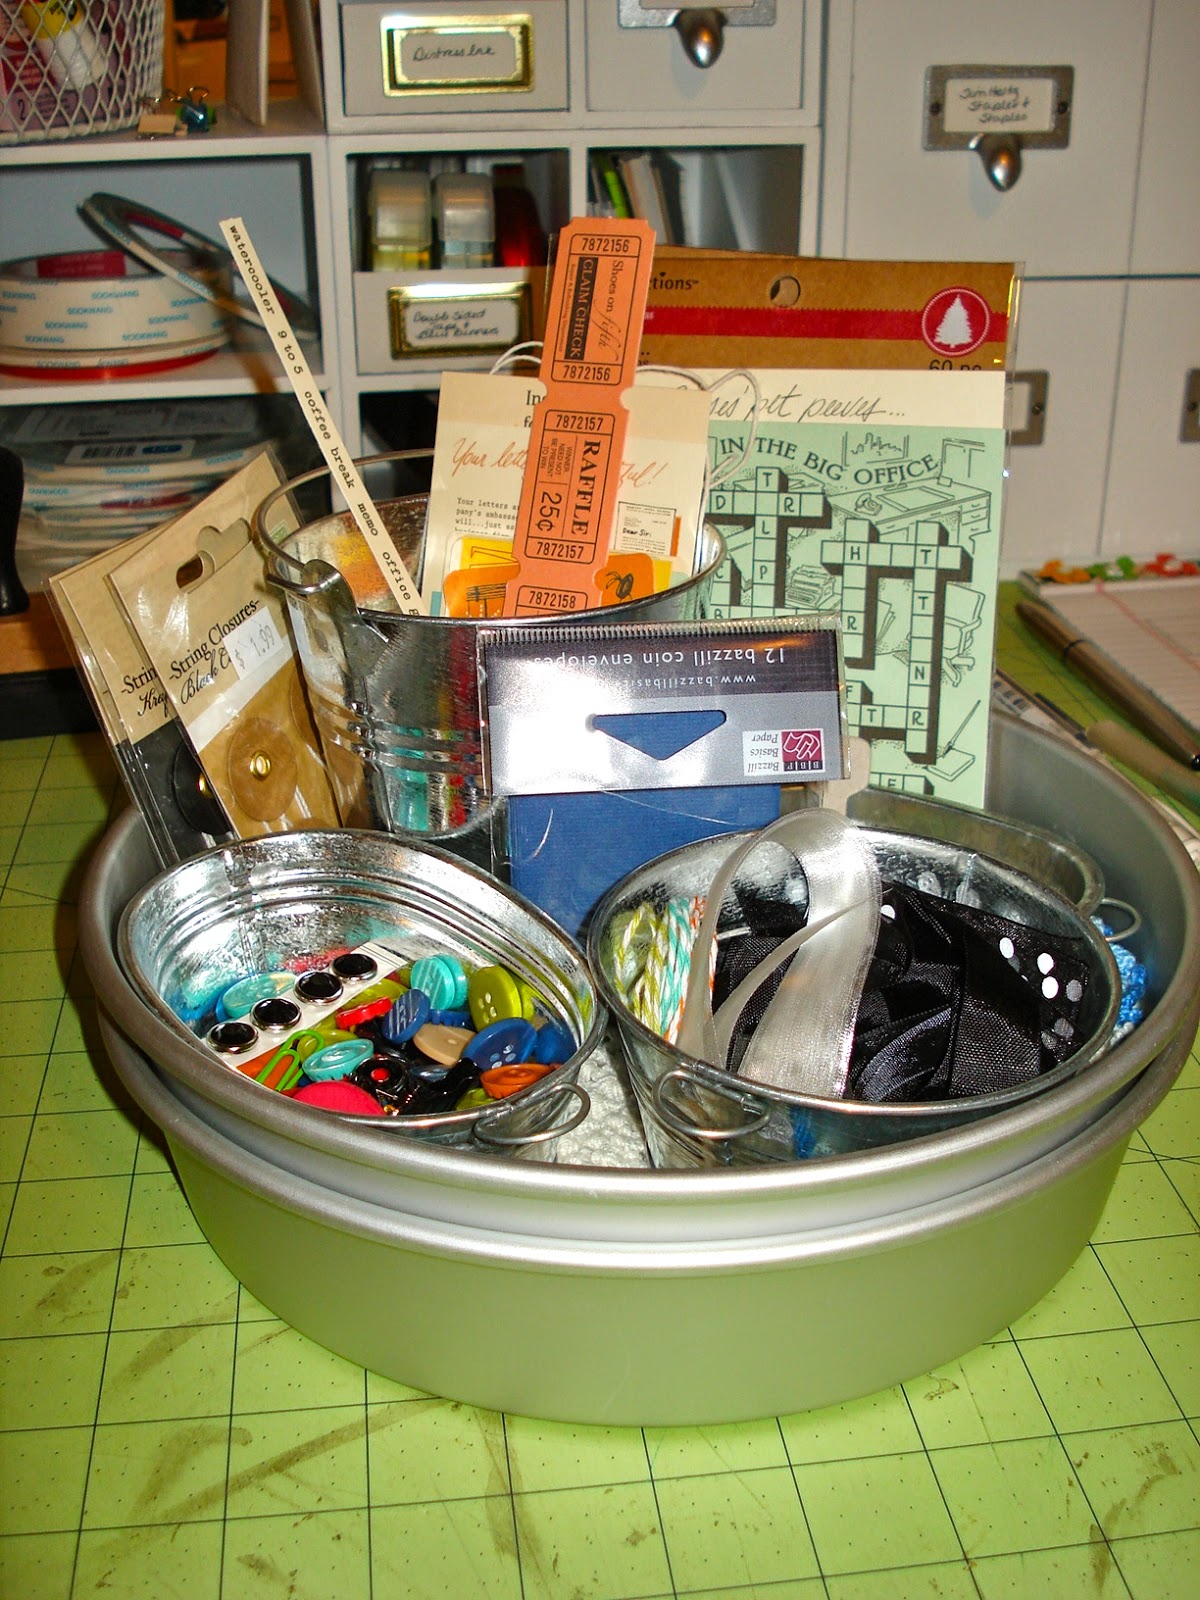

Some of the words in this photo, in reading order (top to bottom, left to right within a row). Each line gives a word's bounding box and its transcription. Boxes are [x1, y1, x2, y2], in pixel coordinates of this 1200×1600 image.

[581, 237, 630, 253] 7872156
[579, 259, 594, 303] CLAIM
[608, 259, 625, 295] Shoes
[605, 296, 617, 313] on
[569, 306, 588, 358] CHECK
[563, 365, 611, 381] 7872156
[229, 225, 275, 315] watercooler
[277, 330, 287, 339] 9
[284, 345, 295, 361] to
[293, 366, 304, 375] 5
[304, 391, 331, 440] coffee
[330, 447, 355, 489] break
[357, 502, 378, 537] memo
[382, 551, 411, 601] office
[556, 414, 604, 431] 7872157
[452, 438, 487, 477] Your
[720, 437, 744, 454] IN
[755, 437, 798, 460] THE
[803, 451, 844, 480] BIG
[854, 454, 939, 485] OFFICE
[571, 440, 602, 536] RAFFLE
[457, 497, 475, 507] Your
[478, 498, 509, 510] letters
[537, 491, 562, 532] 25¢
[623, 527, 638, 535] Dear
[536, 542, 584, 559] 7872157
[529, 591, 576, 608] 7872158
[534, 652, 633, 666] envelopes
[643, 651, 684, 667] coin
[694, 649, 755, 667] bazzill
[766, 648, 785, 664] 12
[181, 649, 219, 704] Black
[751, 733, 779, 743] Paper
[750, 747, 779, 757] Basics
[748, 761, 780, 772] Bazzill
